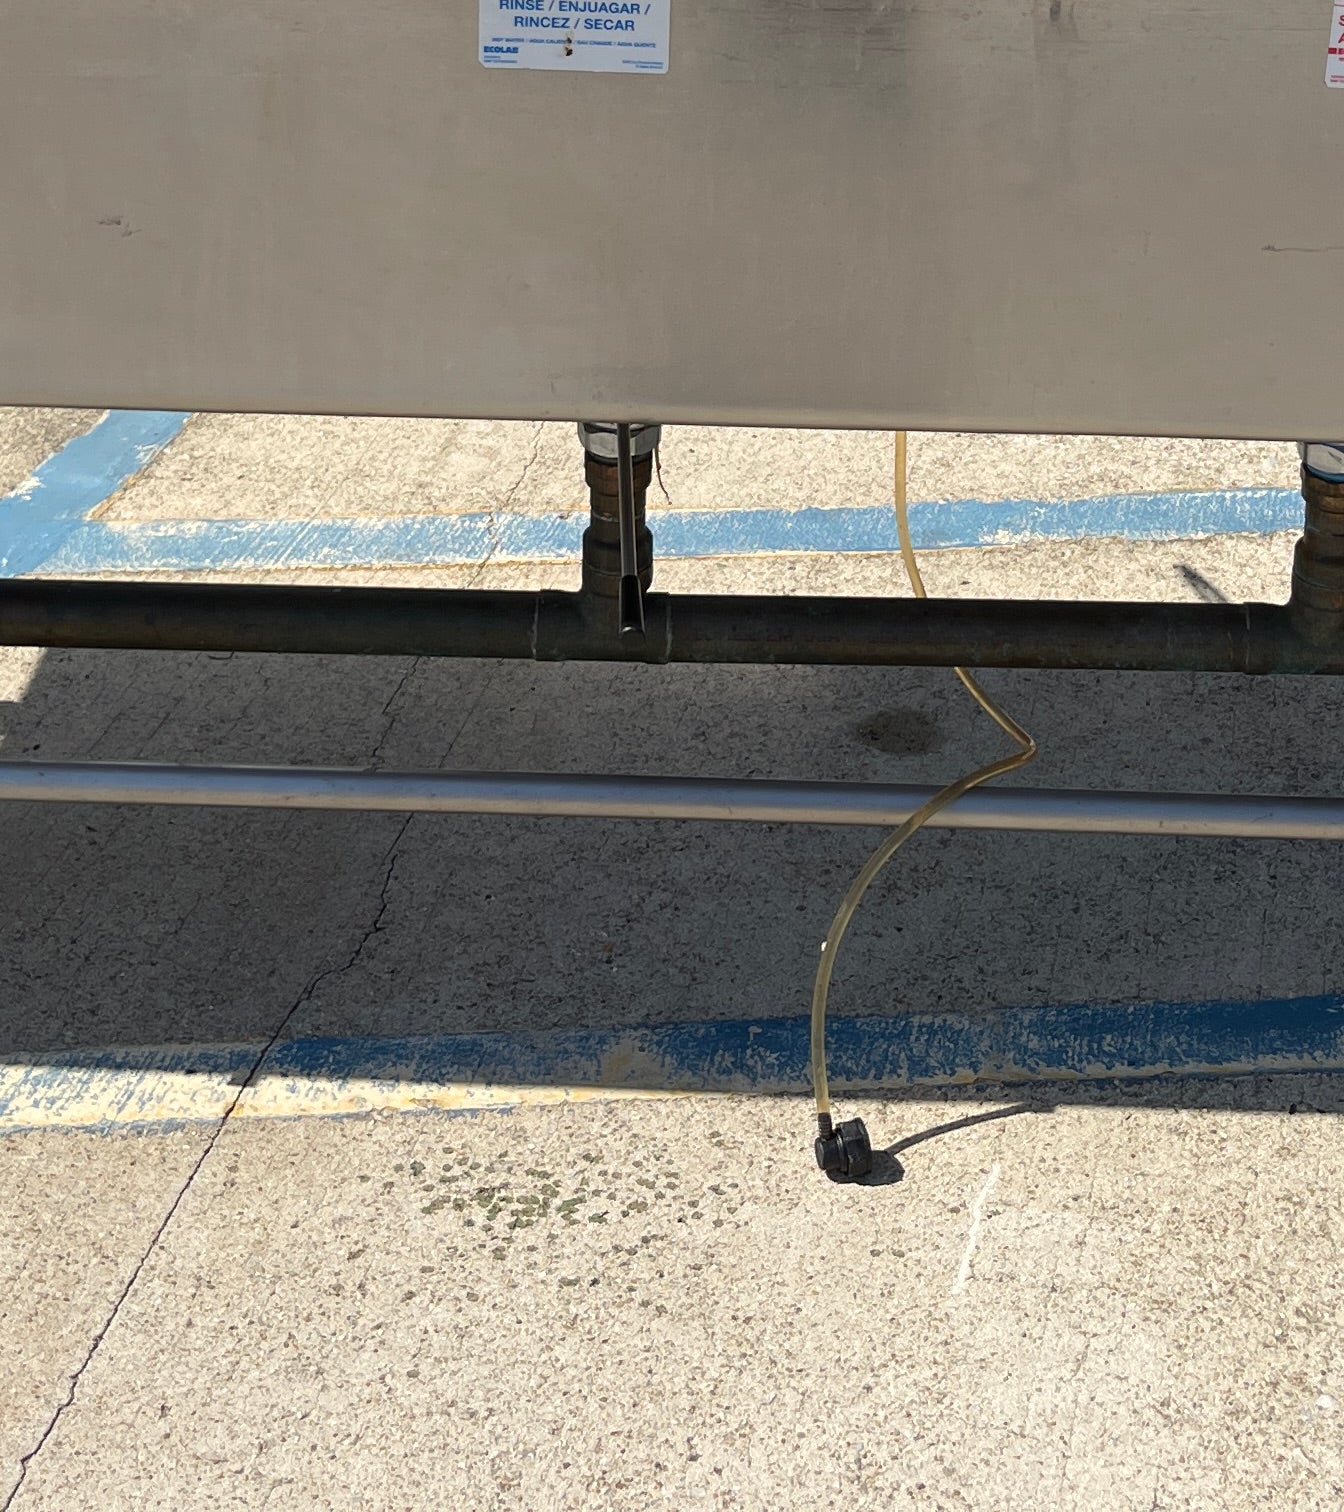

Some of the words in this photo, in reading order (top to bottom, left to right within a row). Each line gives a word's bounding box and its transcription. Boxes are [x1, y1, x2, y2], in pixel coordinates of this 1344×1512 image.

[559, 0, 640, 14] ENJUAGAR
[514, 16, 570, 29] RINCEZ
[584, 18, 635, 31] SECAR
[483, 46, 519, 54] ECOLAB
